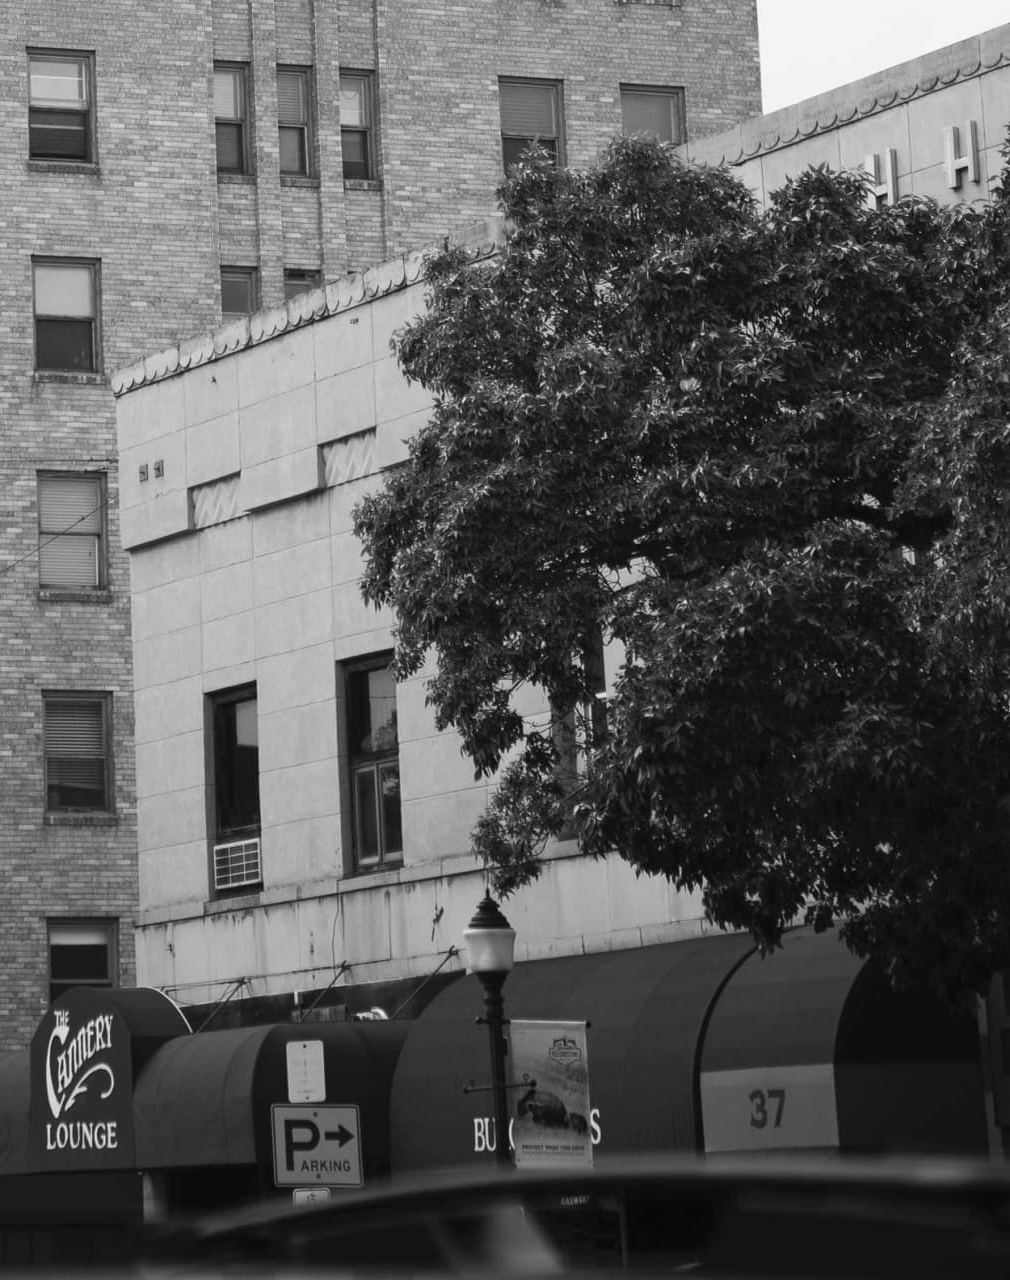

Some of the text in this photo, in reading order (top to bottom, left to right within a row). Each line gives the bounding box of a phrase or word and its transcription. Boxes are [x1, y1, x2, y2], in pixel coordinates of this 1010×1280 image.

[54, 1010, 70, 1027] THE
[749, 1086, 786, 1130] 37
[46, 1121, 118, 1151] LOUNGE
